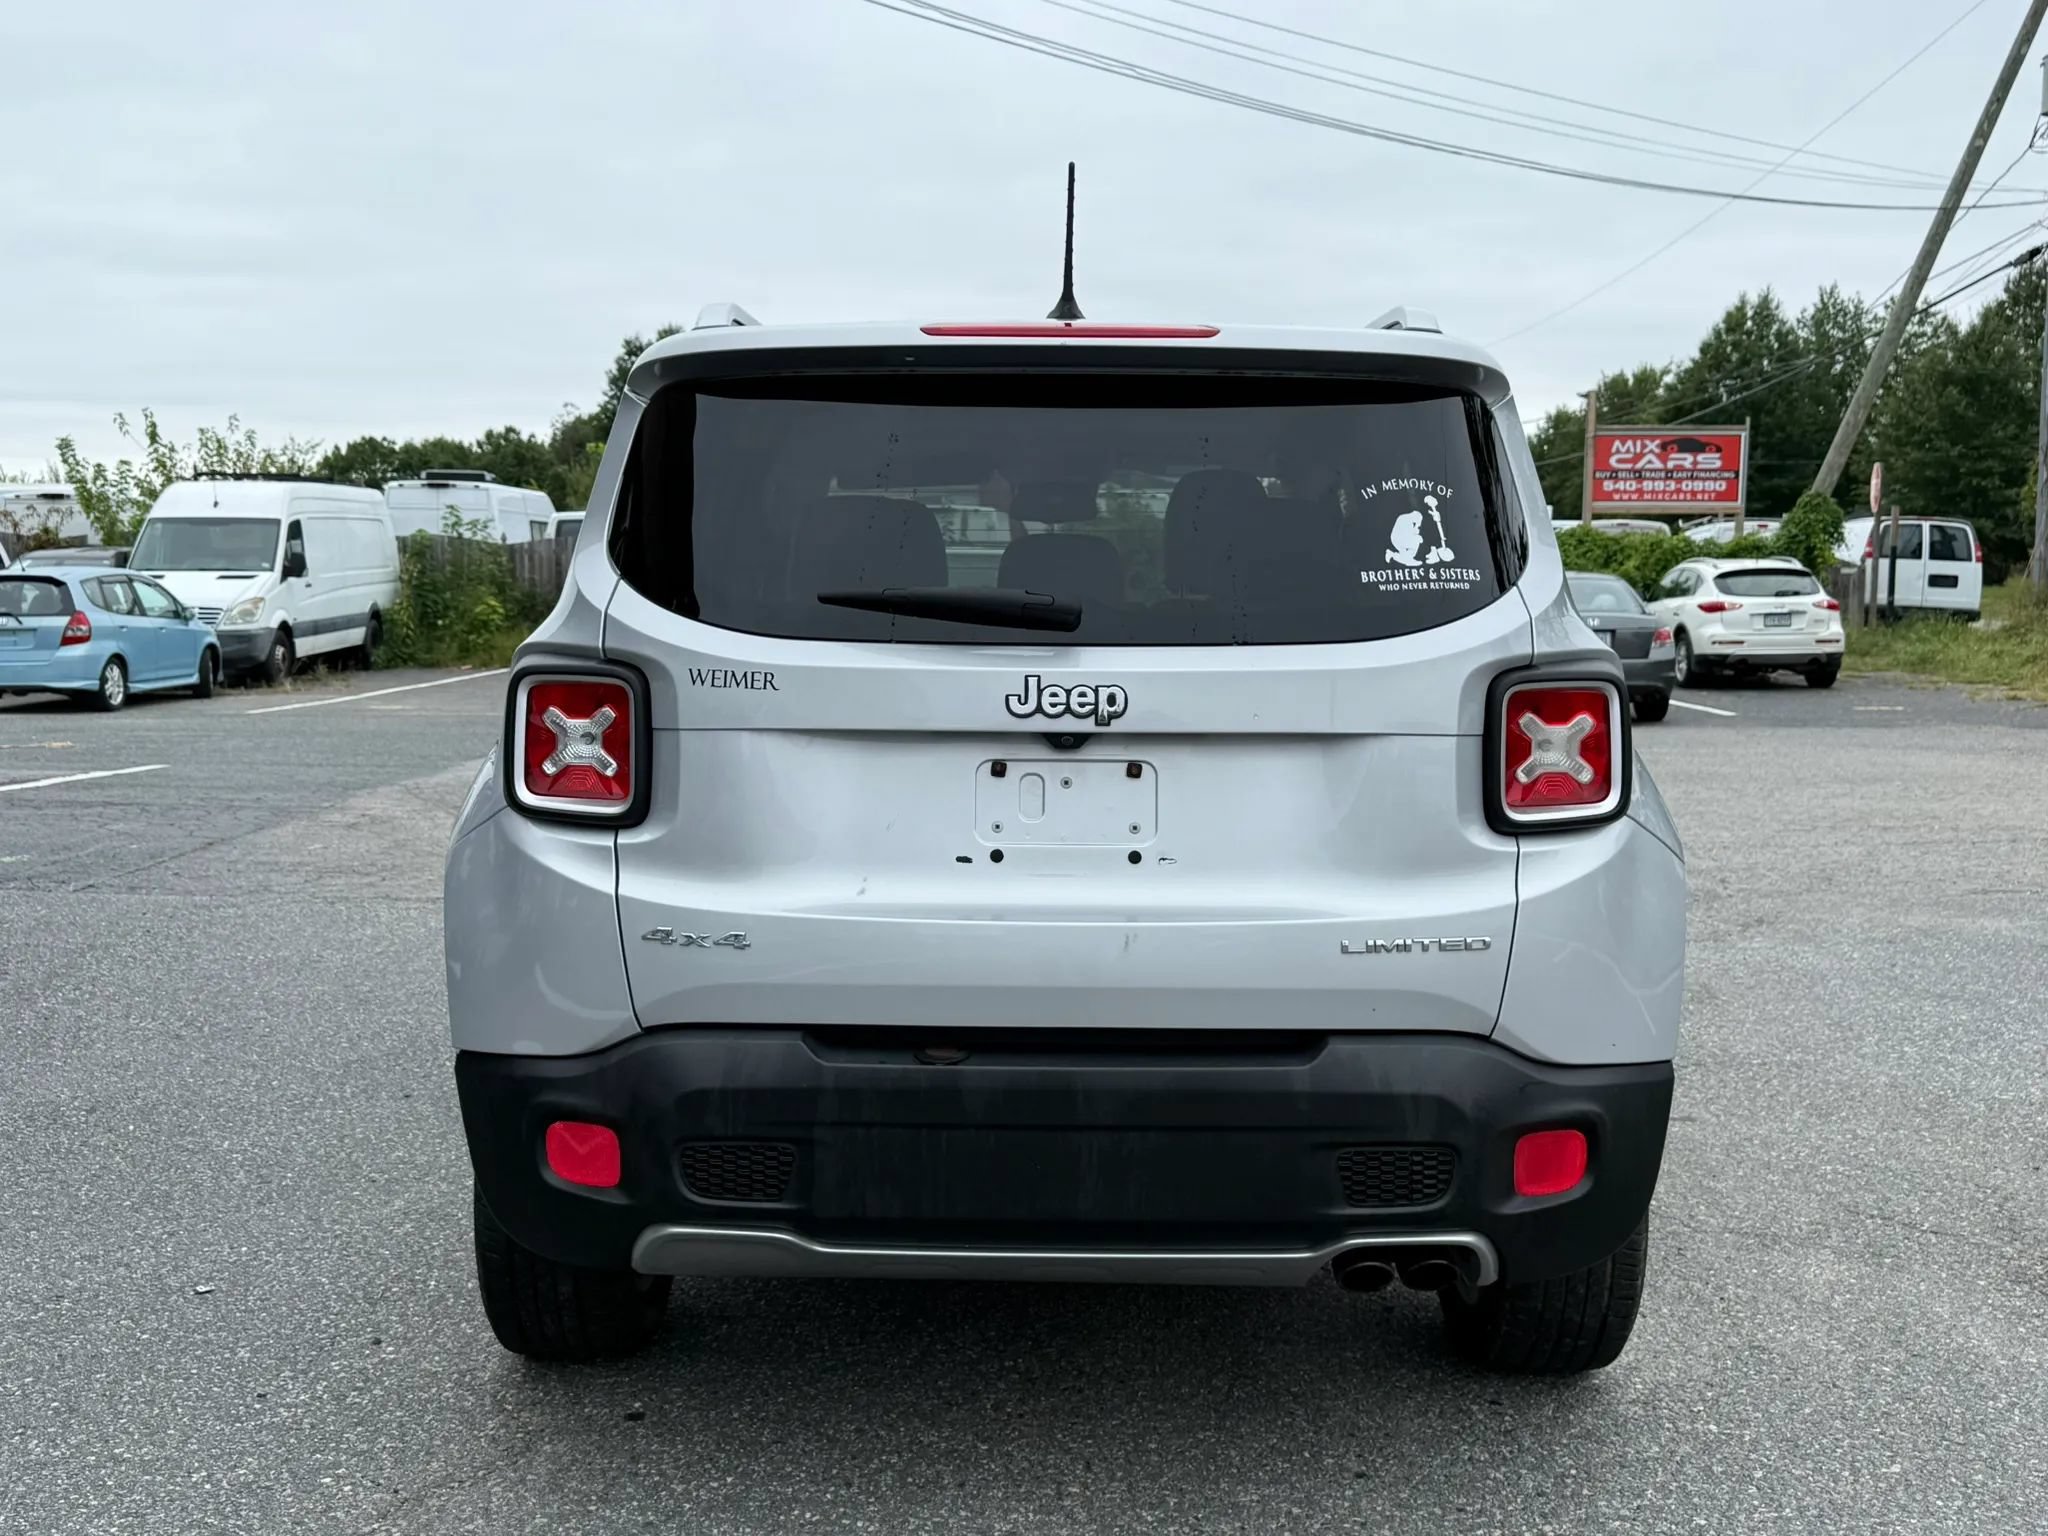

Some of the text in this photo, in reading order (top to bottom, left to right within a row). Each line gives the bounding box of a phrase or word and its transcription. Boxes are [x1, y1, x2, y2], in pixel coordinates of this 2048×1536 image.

[1611, 439, 1662, 454] MIX
[1609, 453, 1723, 469] CARS
[1361, 478, 1454, 500] IN MEMORY OF
[1360, 568, 1480, 583] BROTHERS & SISTERS
[1379, 581, 1470, 591] WHO NEVER RETURNED
[688, 668, 780, 691] WEIMER
[1005, 675, 1128, 726] Jeep
[1340, 935, 1492, 954] LIMITED
